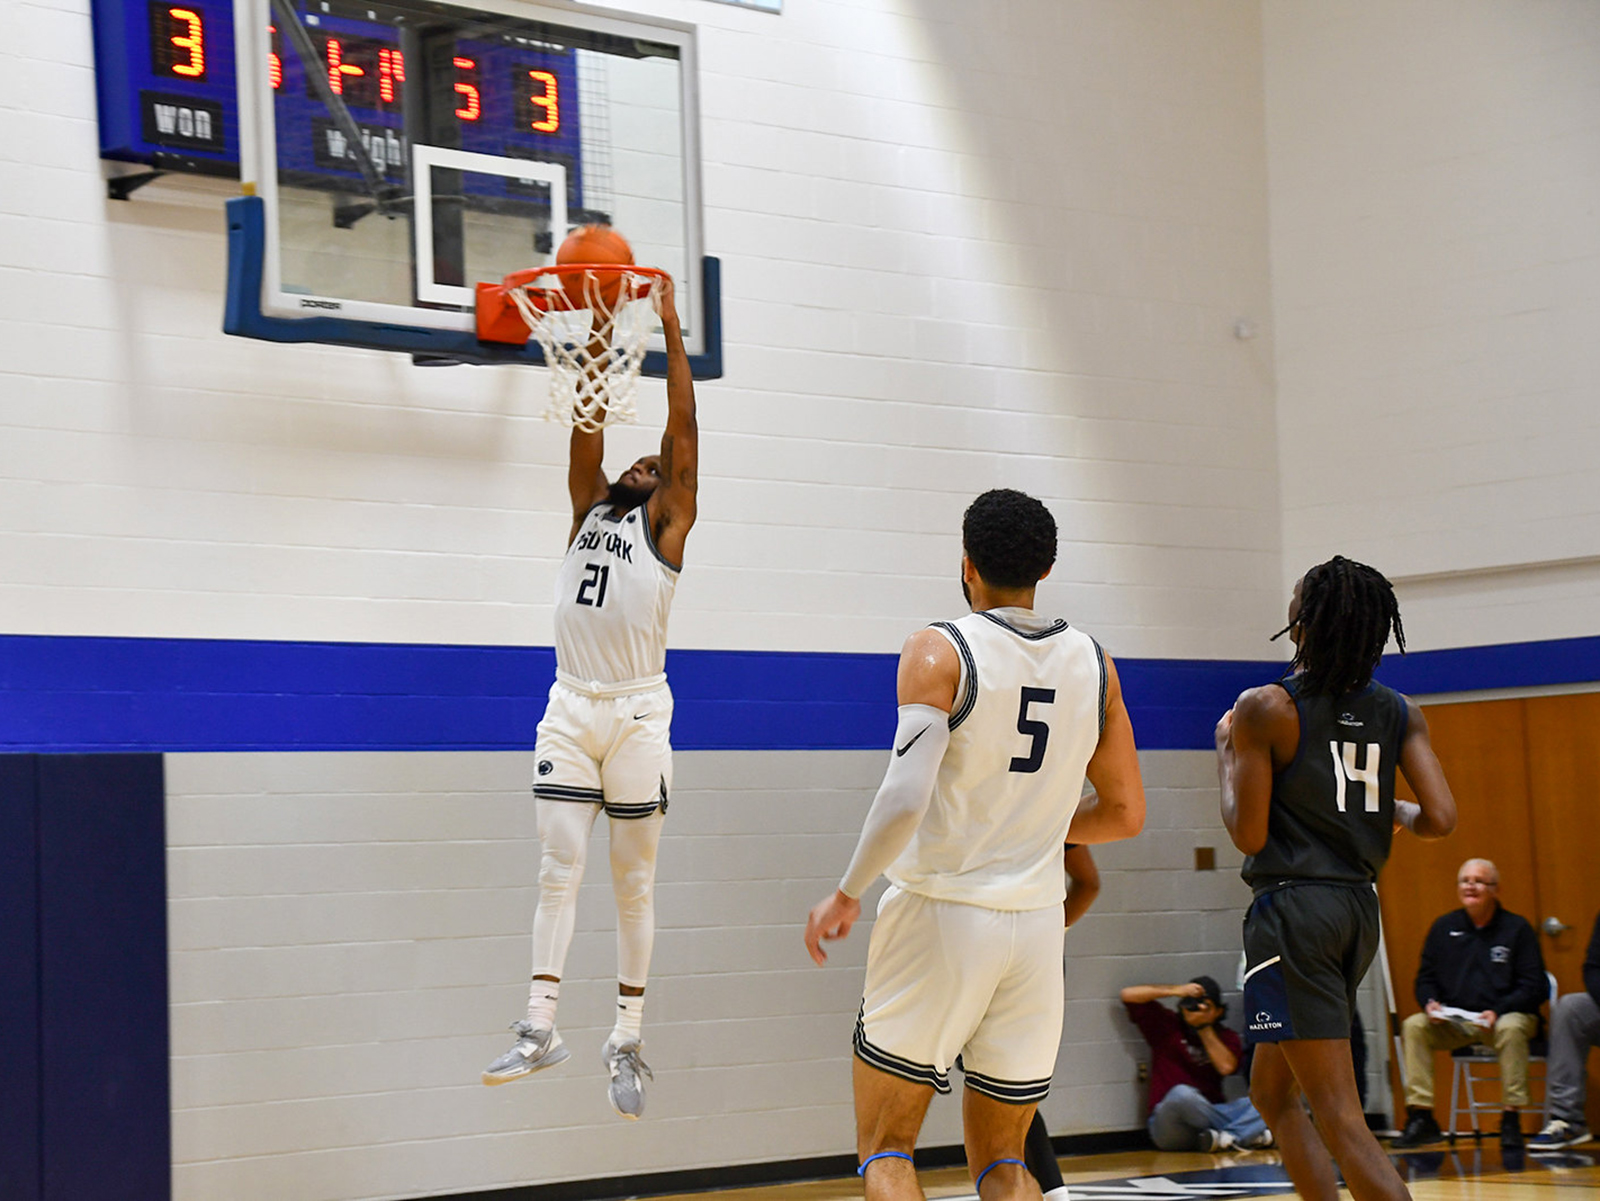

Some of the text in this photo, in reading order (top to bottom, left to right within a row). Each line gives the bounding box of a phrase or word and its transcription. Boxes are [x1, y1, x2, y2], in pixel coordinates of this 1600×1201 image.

[169, 8, 204, 76] 3
[153, 103, 212, 140] won
[529, 70, 559, 133] 3
[573, 530, 600, 554] SU
[576, 563, 610, 607] 21
[1008, 686, 1056, 773] 5
[1329, 740, 1381, 812] 14
